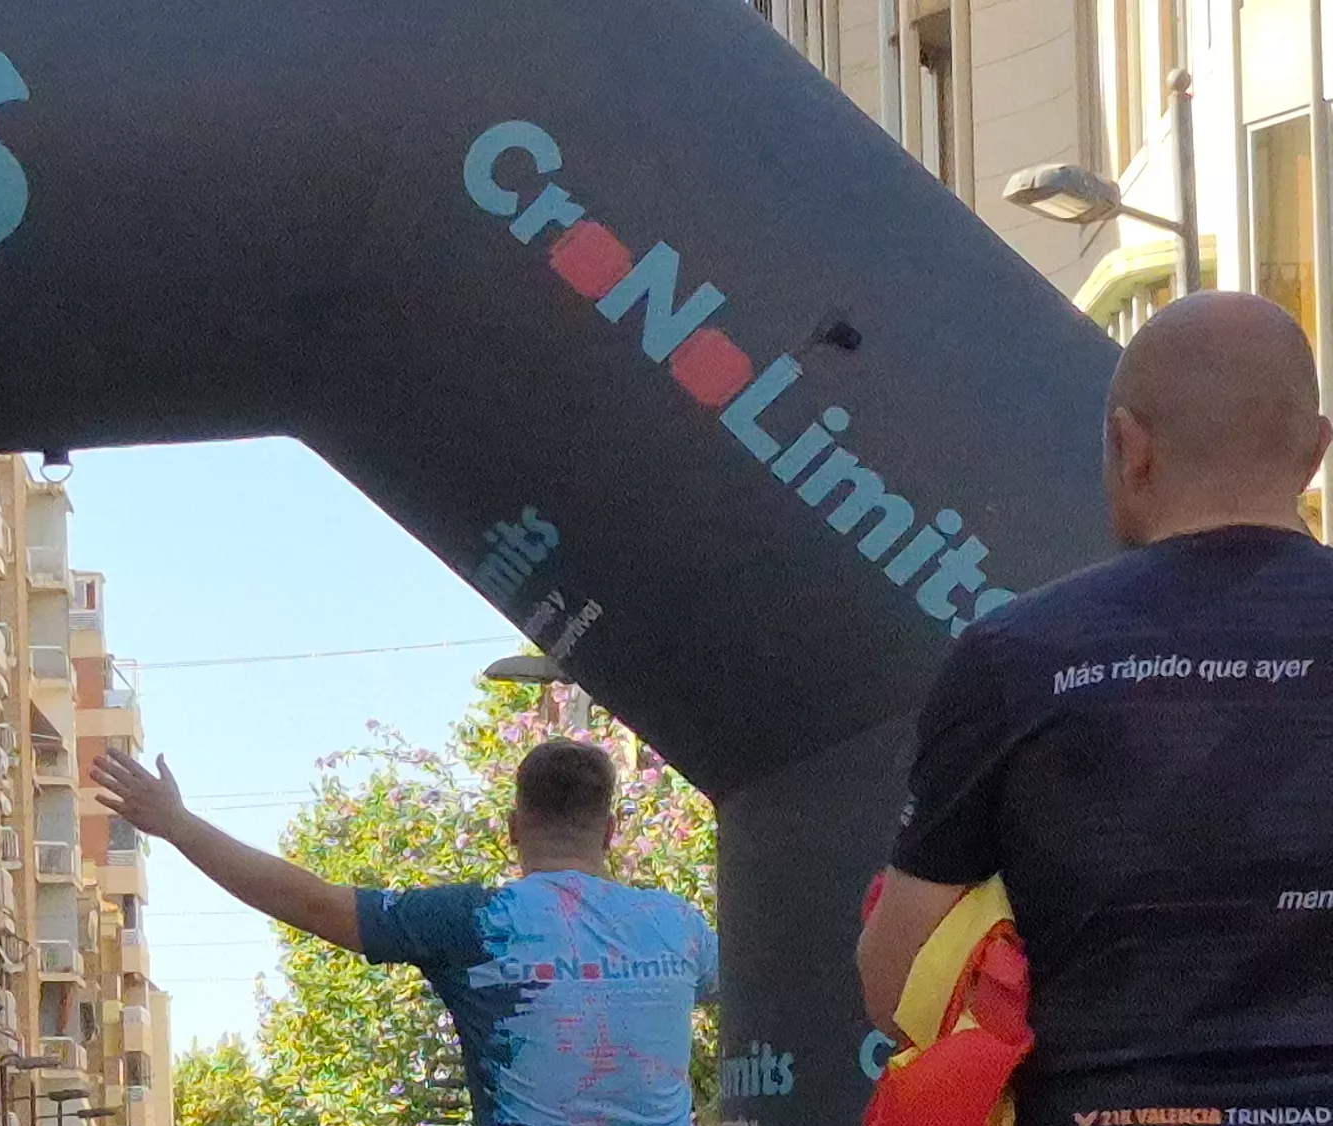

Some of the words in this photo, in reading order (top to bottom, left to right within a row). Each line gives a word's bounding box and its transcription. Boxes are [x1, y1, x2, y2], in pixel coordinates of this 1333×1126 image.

[1053, 660, 1105, 695] Más
[1111, 653, 1191, 683] rápido
[1198, 658, 1248, 682] que
[1254, 657, 1314, 683] ayer
[1135, 1107, 1223, 1126] VALENCIA
[1224, 1106, 1333, 1126] TRINIDAD
